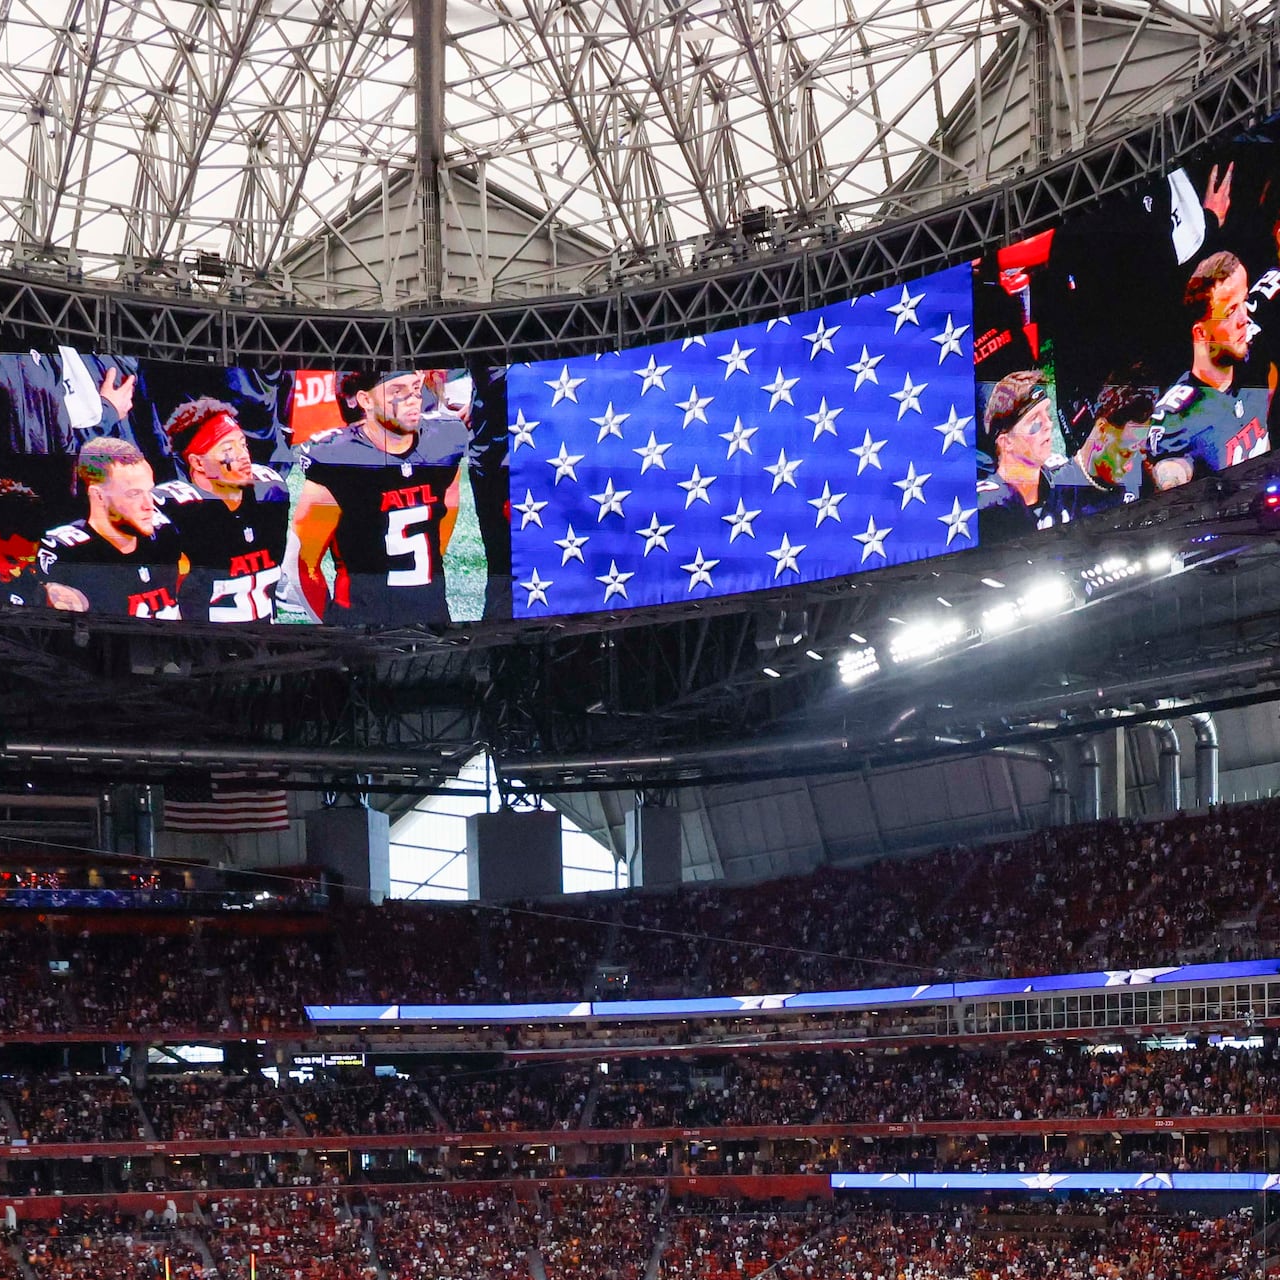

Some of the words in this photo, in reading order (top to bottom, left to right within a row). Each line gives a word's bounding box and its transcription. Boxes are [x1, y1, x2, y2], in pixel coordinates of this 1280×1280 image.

[1225, 416, 1266, 467] ATL
[379, 485, 438, 512] ATL
[385, 506, 432, 586] 5
[229, 550, 277, 578] ATL
[127, 588, 177, 617] ATL
